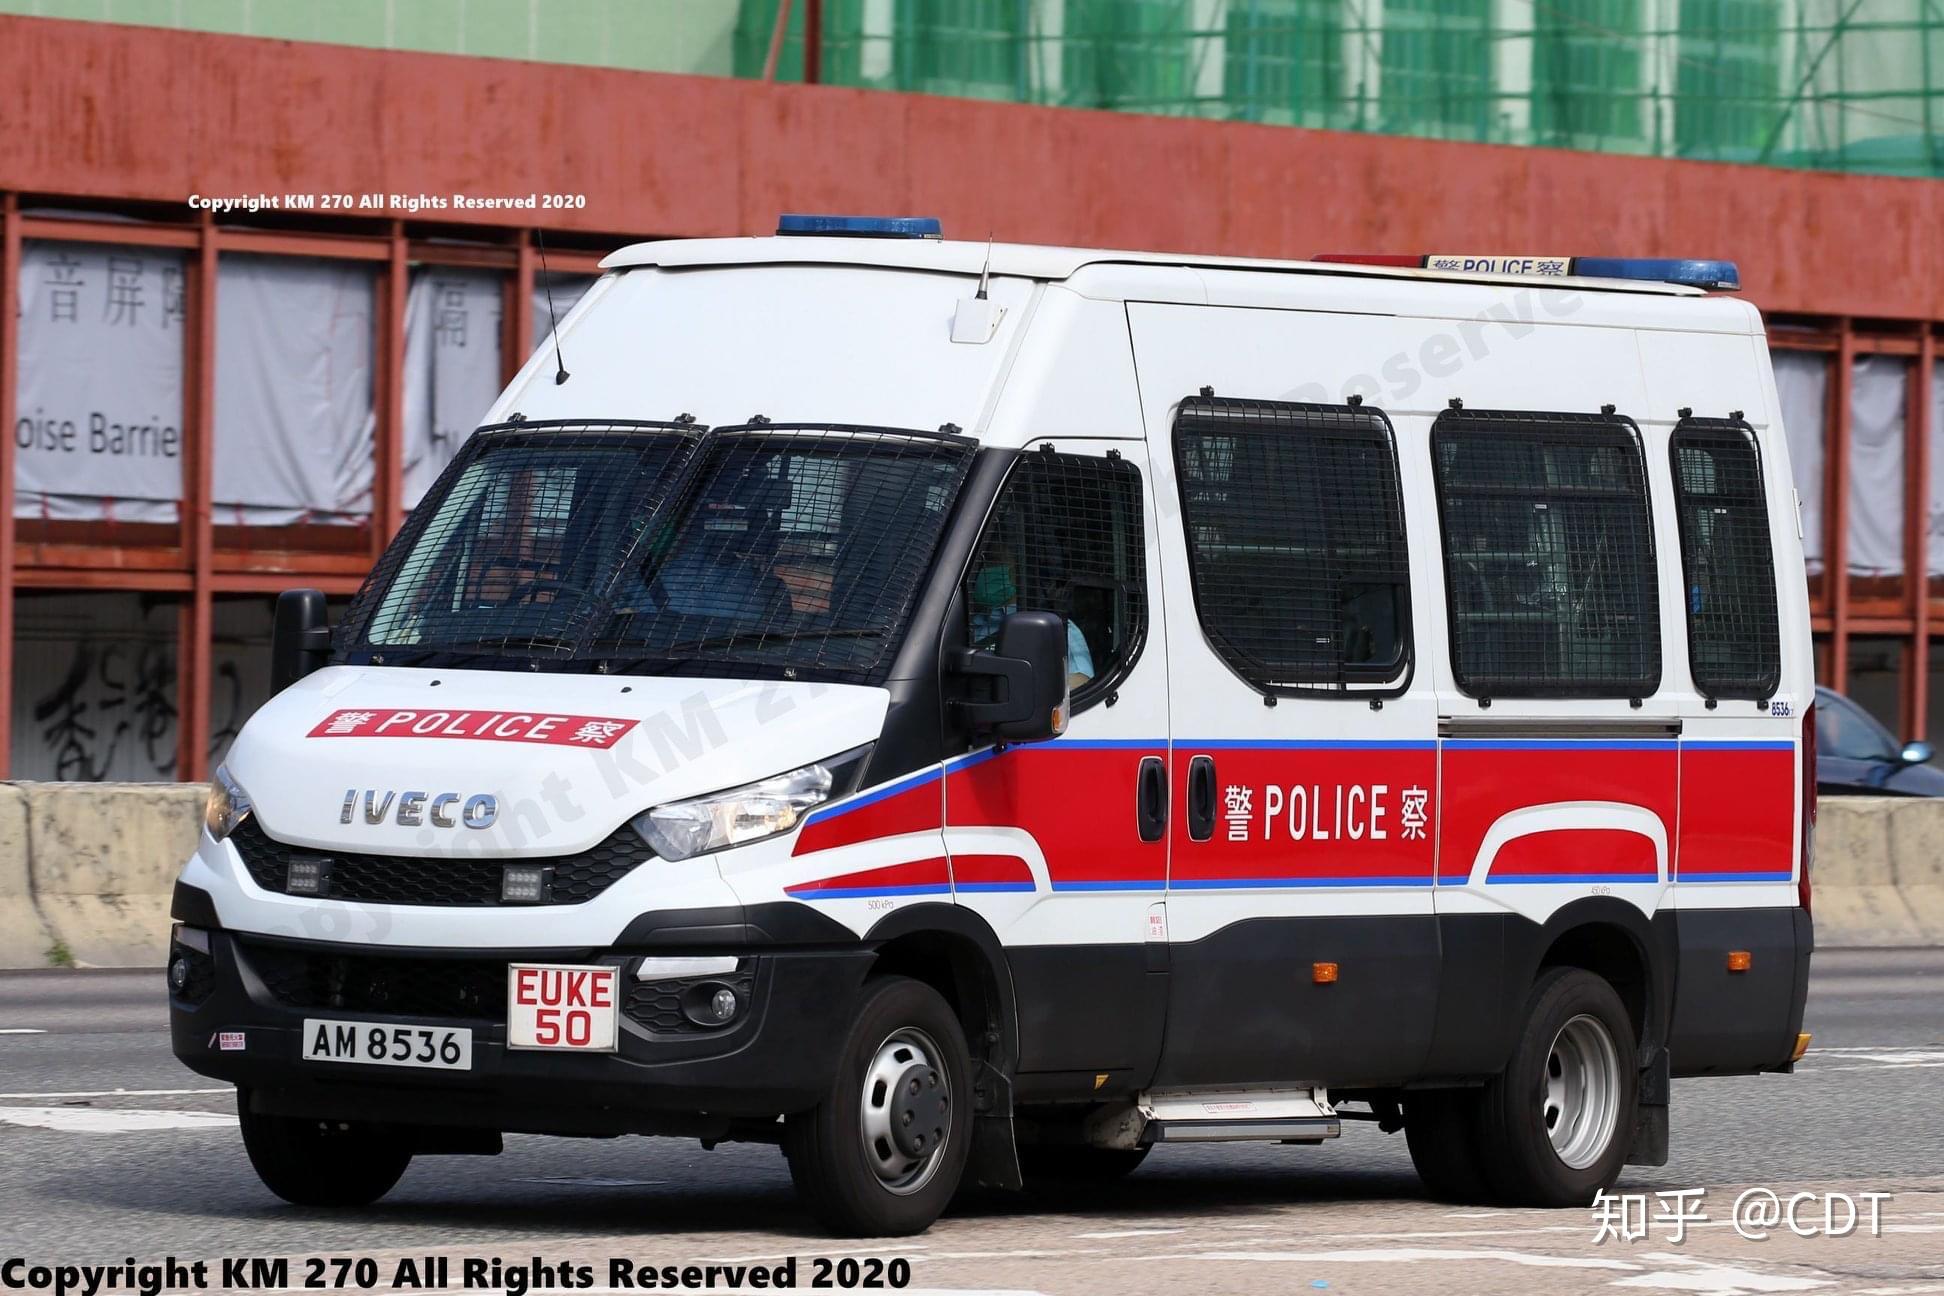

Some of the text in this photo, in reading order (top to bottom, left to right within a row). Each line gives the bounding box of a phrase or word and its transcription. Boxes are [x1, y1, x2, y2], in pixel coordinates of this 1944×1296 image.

[1463, 259, 1534, 274] POLICE
[14, 408, 180, 458] oise Barrie
[324, 711, 626, 745] 警 POLICE 察
[1771, 701, 1790, 716] 8536
[339, 788, 500, 830] IVECO
[1224, 784, 1429, 842] 警 POLICE 察
[516, 969, 612, 1008] EUKE
[312, 1024, 461, 1065] AM 8536
[535, 1009, 591, 1047] 50
